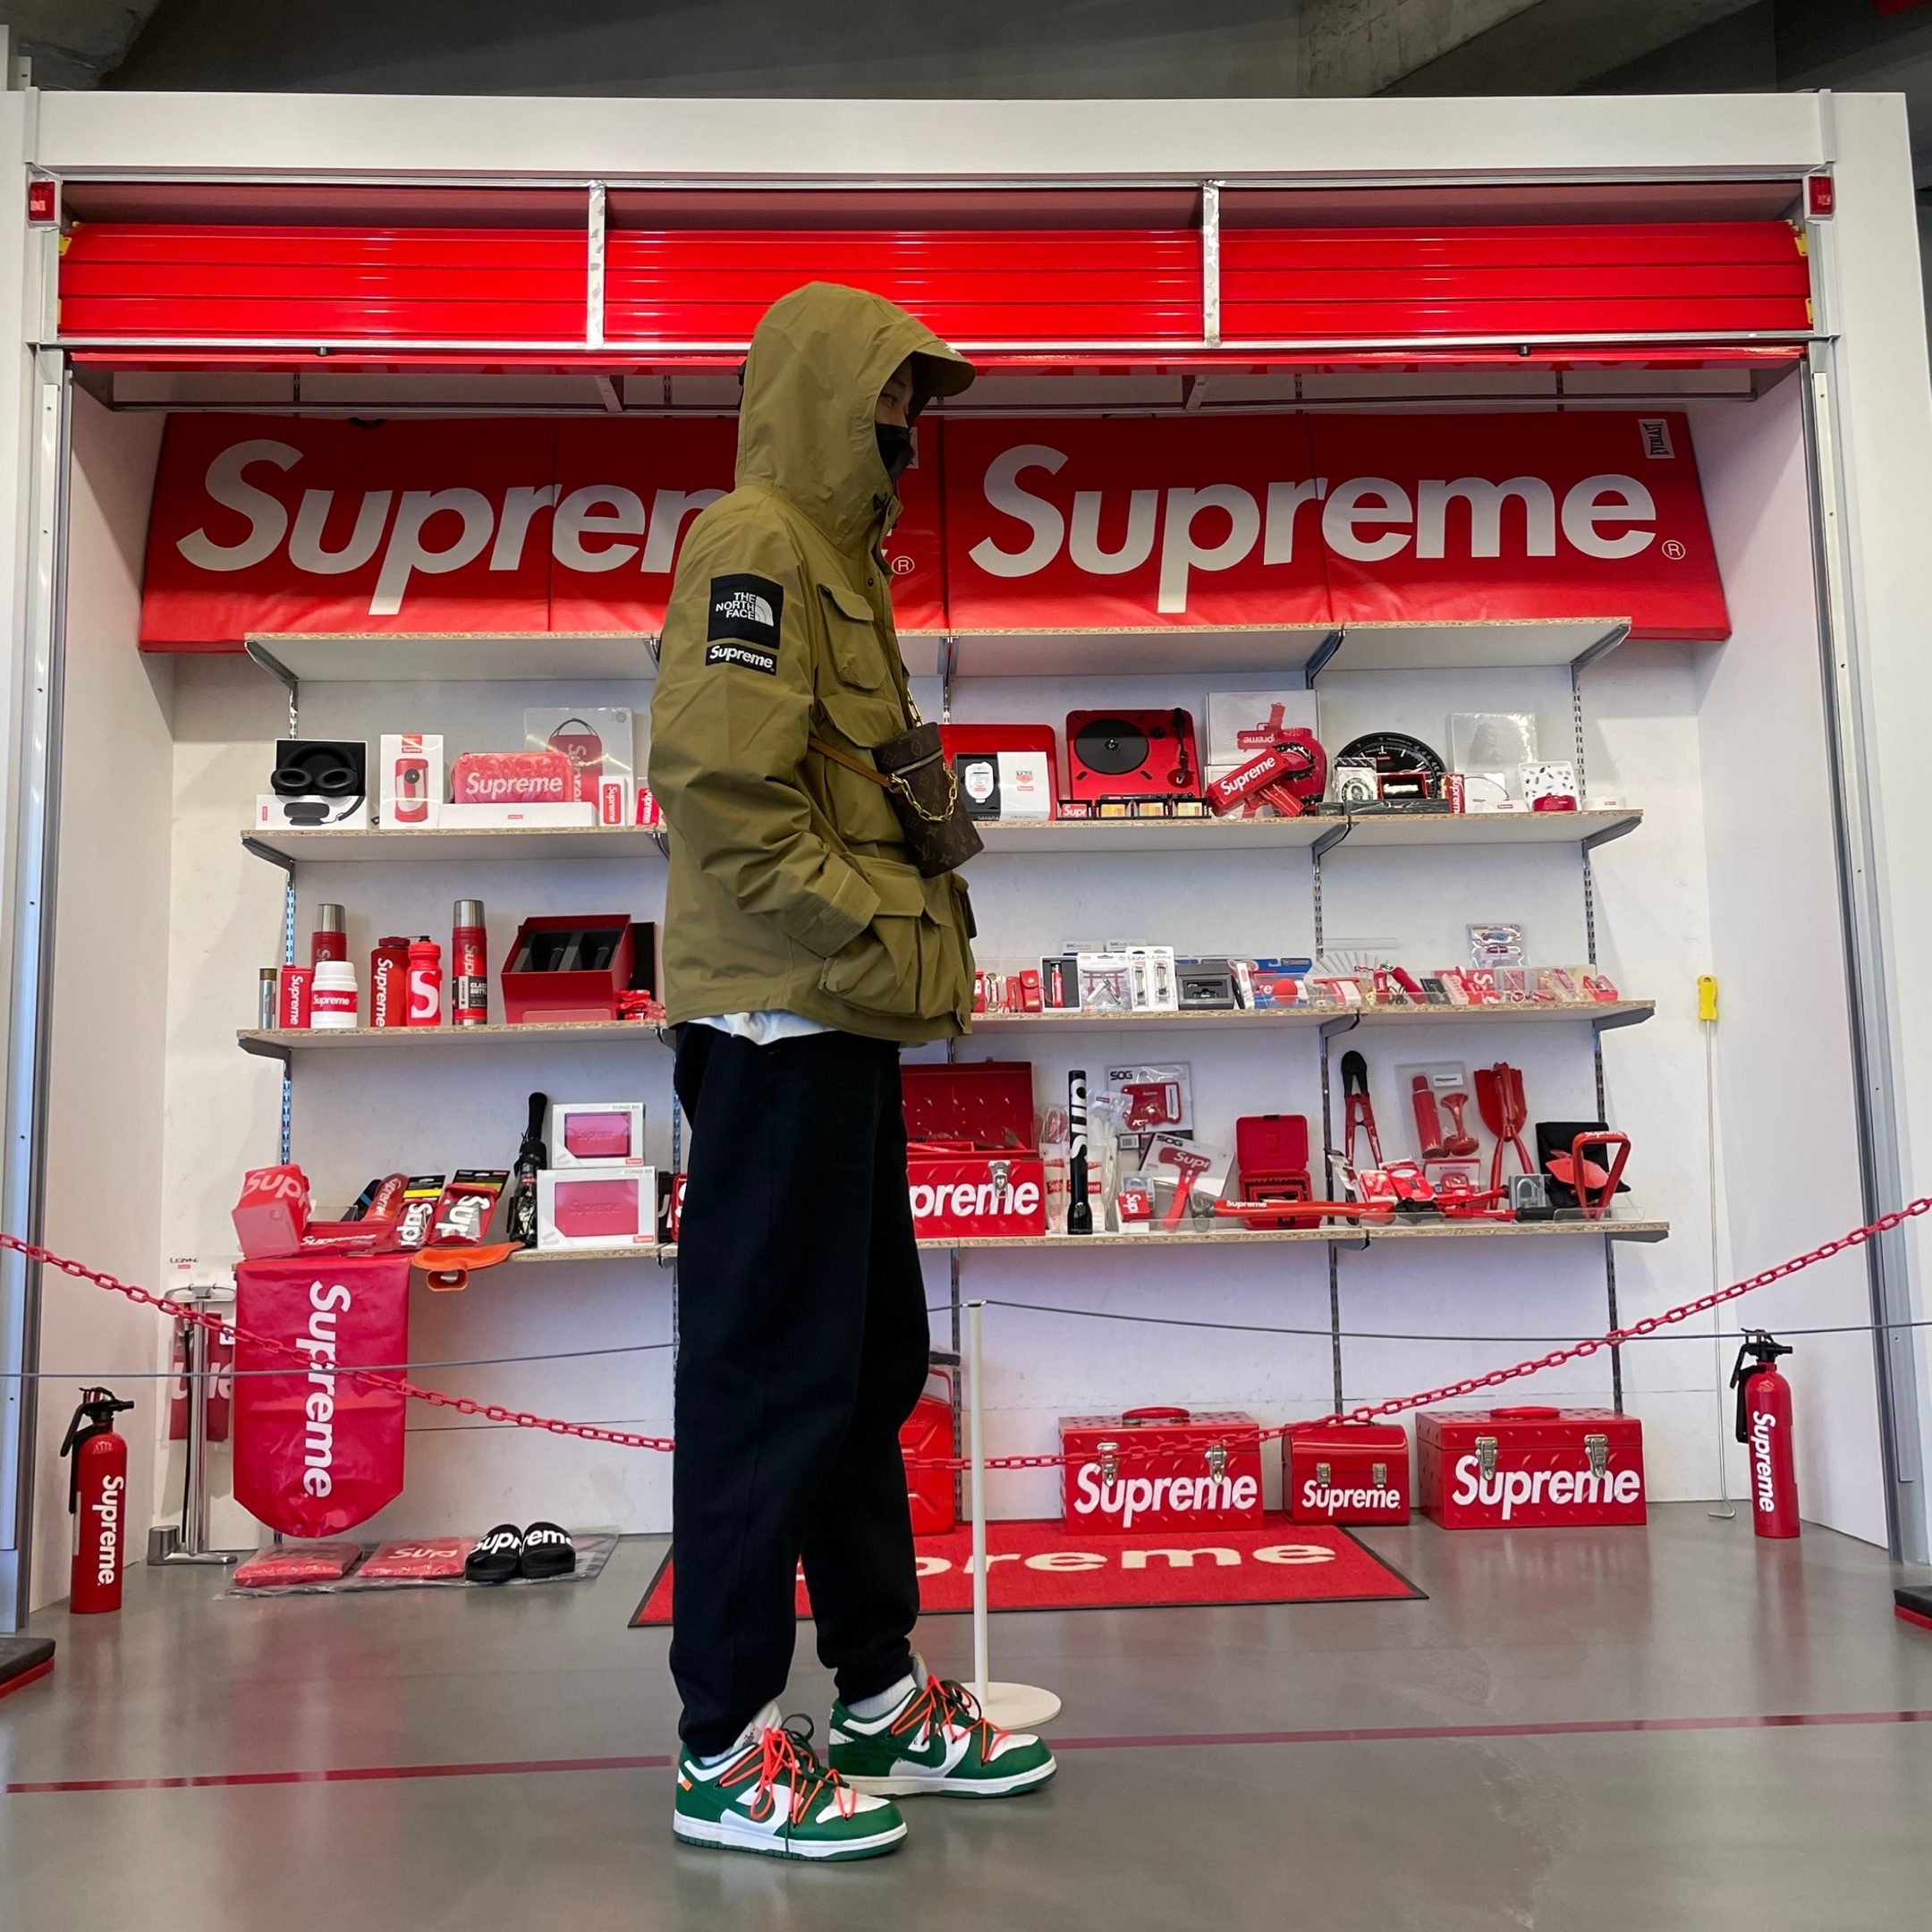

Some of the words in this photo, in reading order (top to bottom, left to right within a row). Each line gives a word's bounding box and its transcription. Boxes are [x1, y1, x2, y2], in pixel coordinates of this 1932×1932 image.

[969, 444, 1657, 614] Supreme
[716, 600, 754, 614] NORTH
[725, 608, 755, 621] FACE
[733, 591, 757, 605] THE
[709, 645, 774, 669] Supreme
[465, 772, 564, 801] Supreme
[1220, 757, 1276, 795] Supreme
[1451, 775, 1462, 814] Suprem
[603, 786, 618, 823] Supreme
[287, 975, 304, 1026] Supreme
[312, 995, 350, 1006] Supreme
[374, 958, 394, 1027] Supreme
[411, 970, 439, 1018] S
[1110, 1071, 1132, 1080] SOG
[1157, 1134, 1183, 1147] SOG
[909, 1182, 1040, 1220] preme
[1225, 1199, 1267, 1208] Supreme
[301, 1234, 377, 1246] Supreme
[296, 1280, 352, 1499] Supreme
[1750, 1411, 1776, 1513] Supreme
[1074, 1462, 1258, 1529] Supreme
[1302, 1479, 1400, 1516] Supreme
[1453, 1454, 1640, 1521] Supreme
[92, 1474, 124, 1585] Supreme
